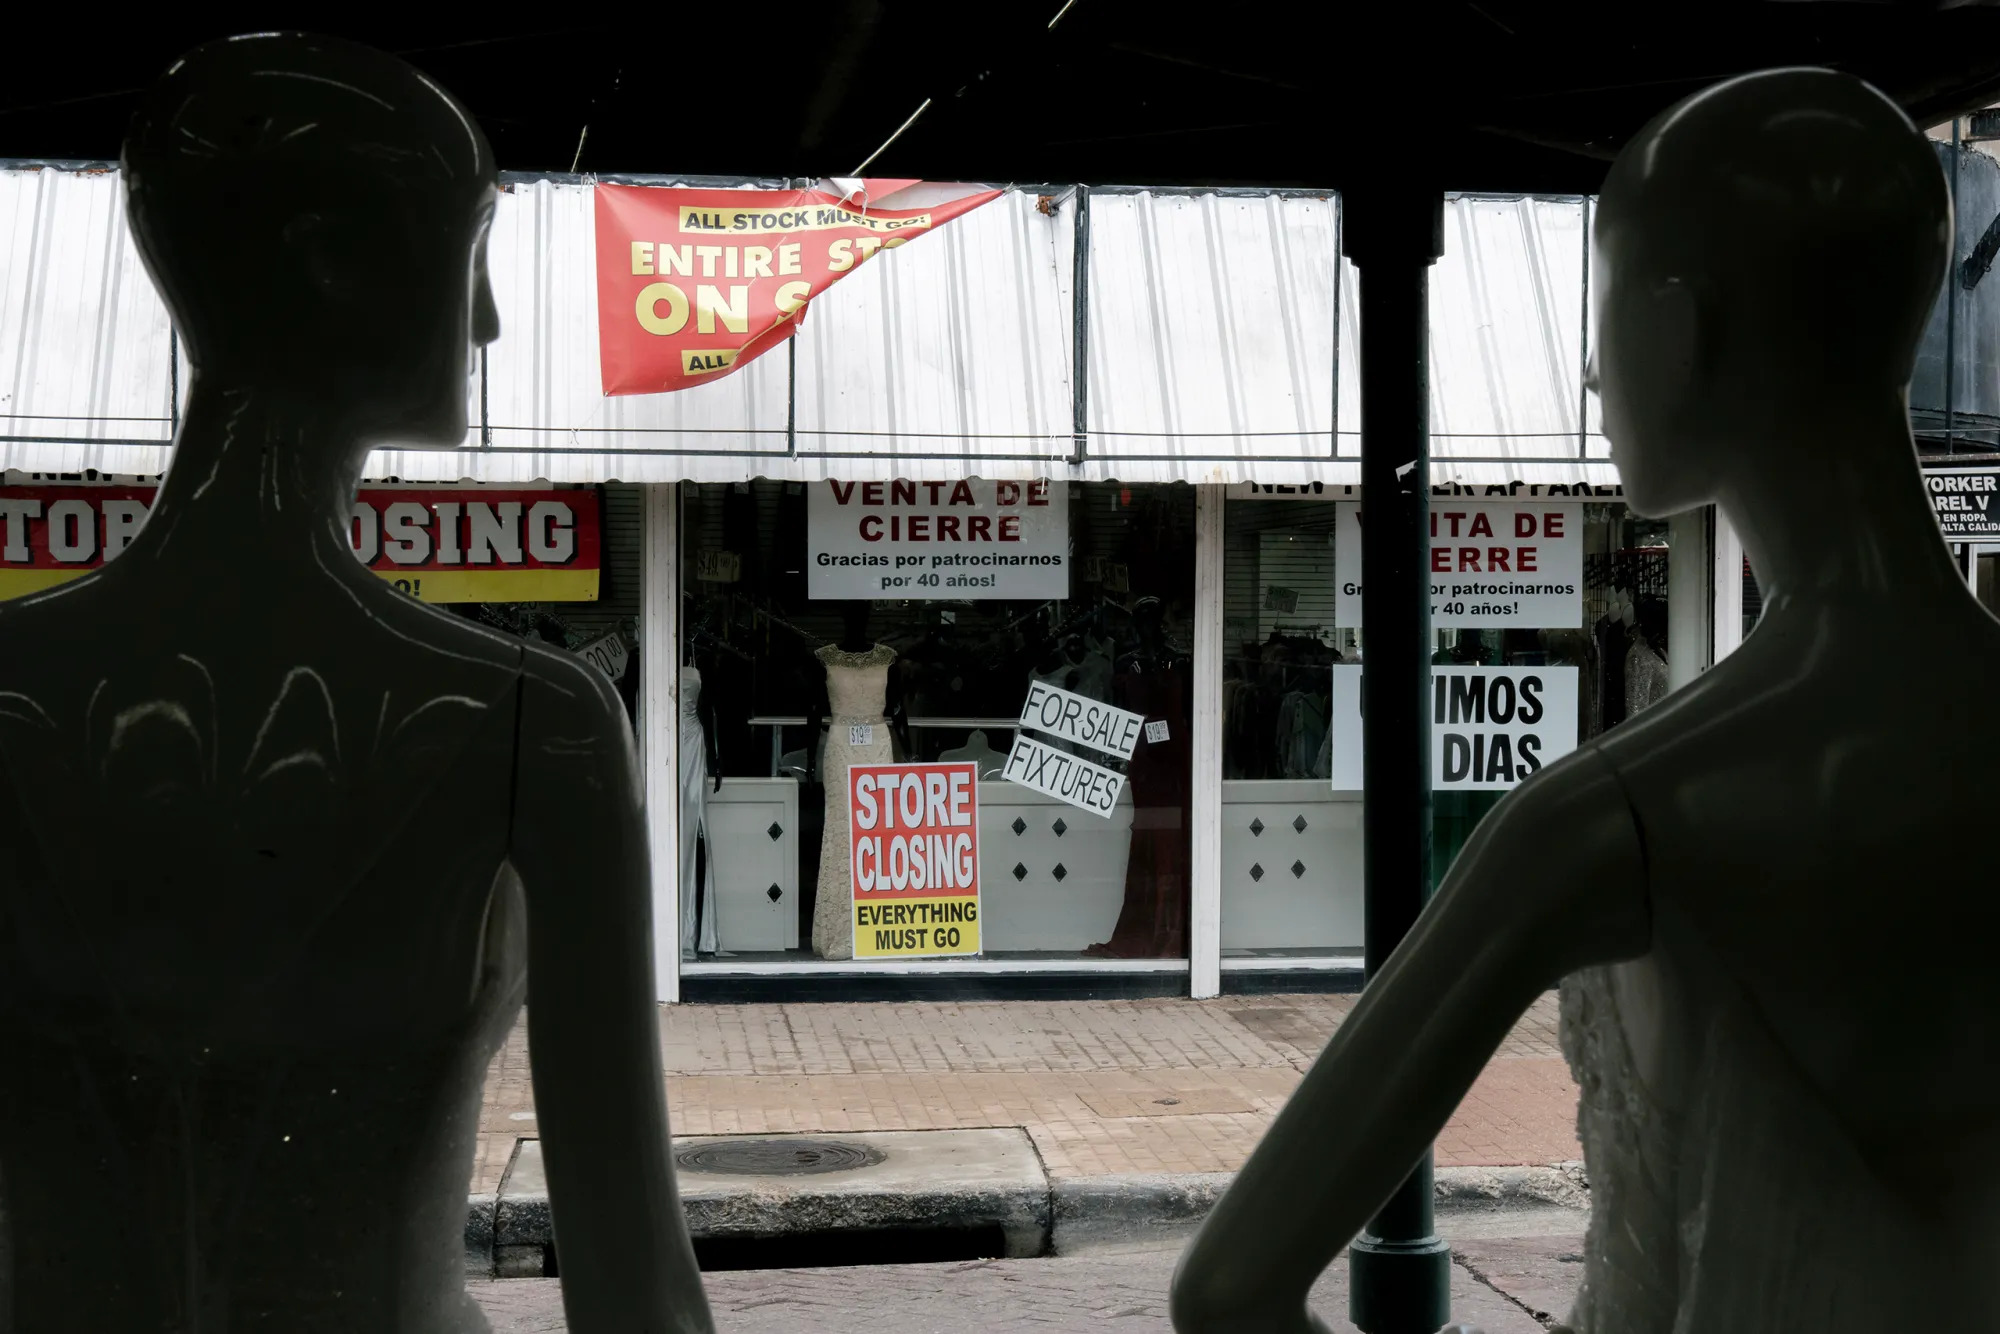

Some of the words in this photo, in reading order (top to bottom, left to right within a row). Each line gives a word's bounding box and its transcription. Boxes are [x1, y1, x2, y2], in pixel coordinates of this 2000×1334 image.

[685, 212, 725, 230] ALL
[733, 209, 809, 230] STOCK
[817, 209, 878, 228] MUST
[884, 216, 926, 230] GO!
[631, 241, 802, 278] ENTIRE
[635, 282, 749, 336] ON
[688, 354, 729, 372] ALL
[830, 480, 976, 506] VENTA
[996, 480, 1049, 506] DE
[859, 515, 1020, 542] CIERRE
[1514, 513, 1564, 538] DE
[1941, 523, 1966, 531] ALTA
[1943, 513, 1957, 522] EN
[1960, 513, 1988, 522] ROPA
[817, 553, 889, 567] Gracias
[896, 556, 926, 568] por
[932, 553, 1061, 568] patrocinarnos
[1431, 547, 1537, 572] ERRE
[881, 576, 912, 589] por
[917, 574, 940, 587] 40
[946, 573, 996, 587] años!
[1452, 581, 1574, 598] patrocinarnos
[1443, 602, 1465, 615] 40
[1471, 601, 1519, 615] años!
[1023, 686, 1082, 736] FOR
[1082, 706, 1139, 754] SALE
[1442, 733, 1542, 783] DIAS
[1007, 741, 1118, 811] FIXTURES
[856, 772, 972, 830] STORE
[856, 832, 975, 892] CLOSING
[857, 902, 977, 926] EVERYTHING
[875, 928, 928, 950] MUST
[933, 927, 961, 949] GO
